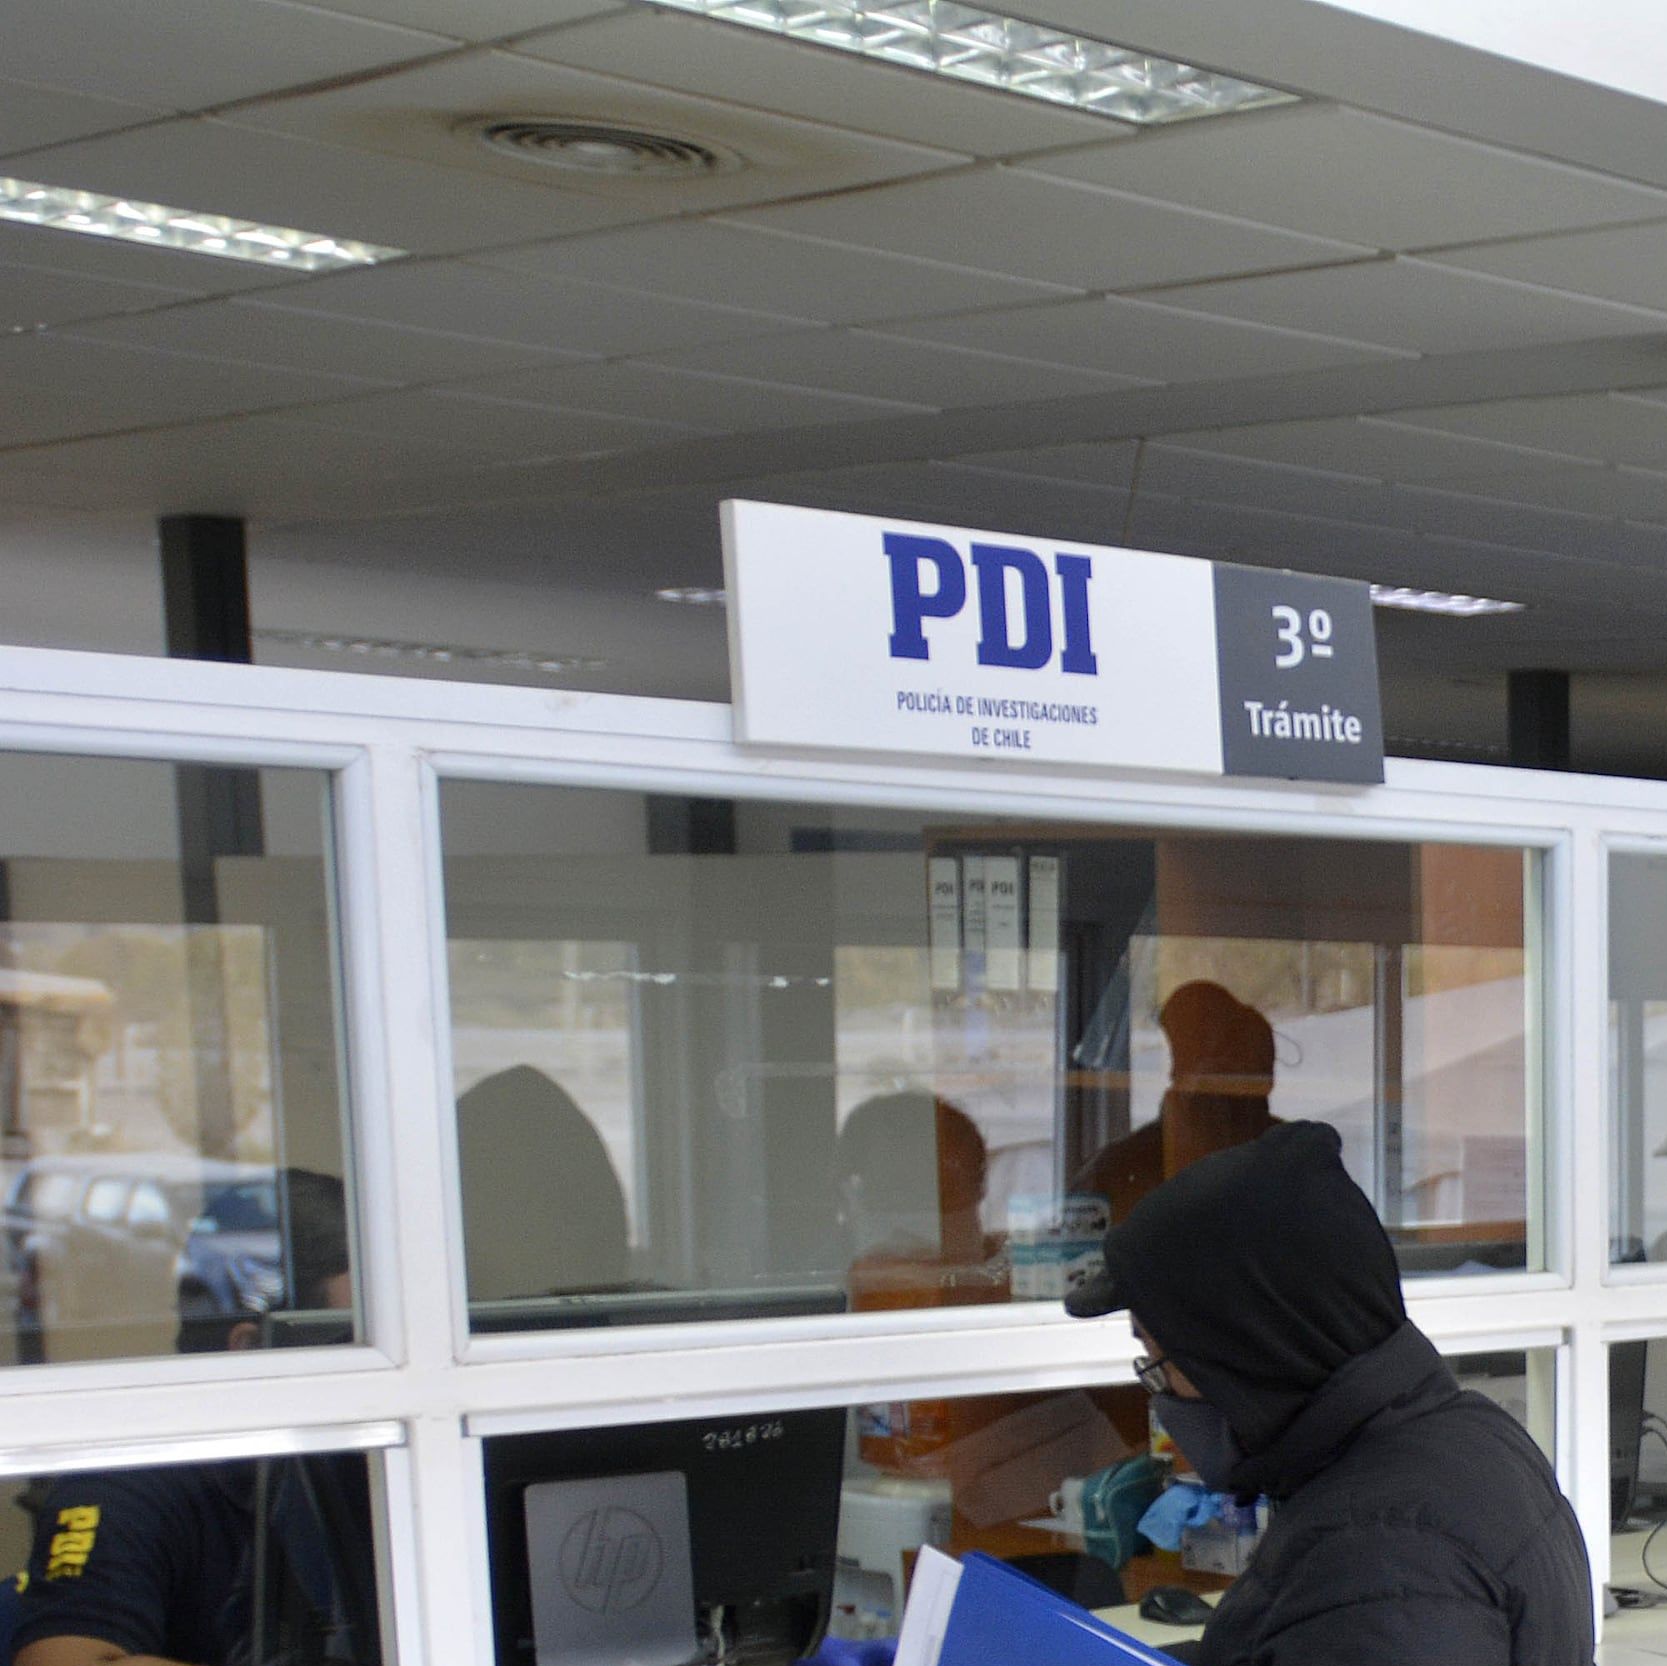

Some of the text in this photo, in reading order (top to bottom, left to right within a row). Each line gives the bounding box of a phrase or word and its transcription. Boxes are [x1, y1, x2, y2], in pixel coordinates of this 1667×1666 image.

[882, 531, 1098, 675] PDI
[897, 688, 1099, 725] POLICÍA DE INVESTIGACIONES
[1244, 700, 1362, 744] Trámite
[972, 727, 1031, 749] DE CHILE
[570, 1506, 657, 1612] hp
